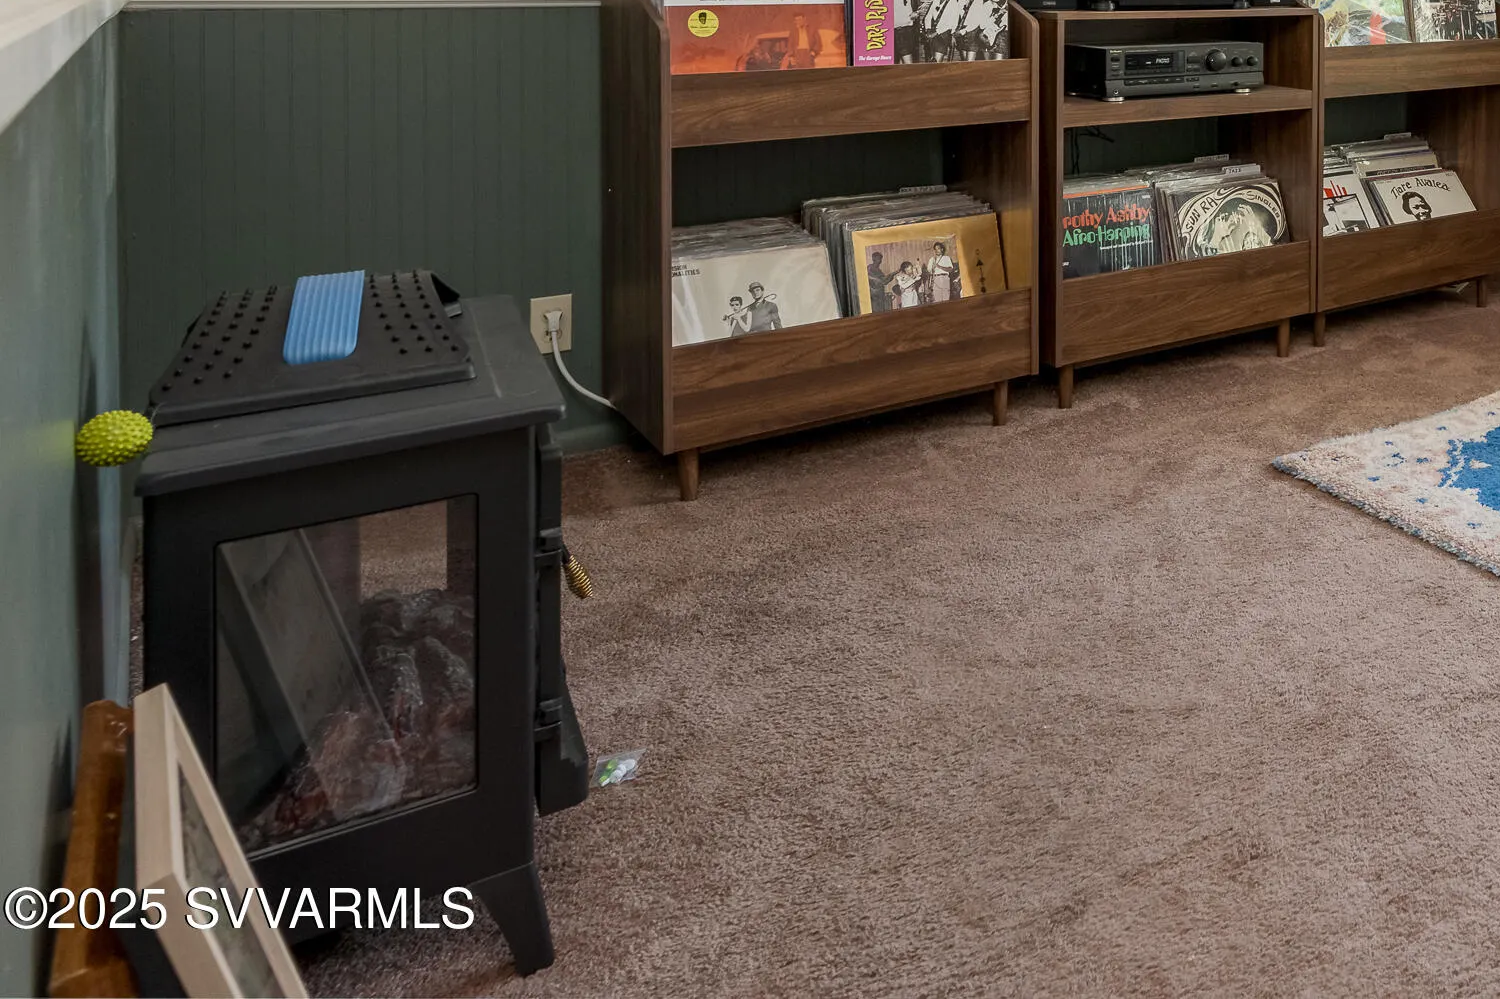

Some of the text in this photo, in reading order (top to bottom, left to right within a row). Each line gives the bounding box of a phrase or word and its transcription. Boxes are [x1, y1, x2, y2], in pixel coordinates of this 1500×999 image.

[865, 22, 889, 51] DARA
[1106, 204, 1150, 224] Ashby
[1185, 196, 1219, 233] SUN RA
[1063, 221, 1151, 247] Afro-Harping
